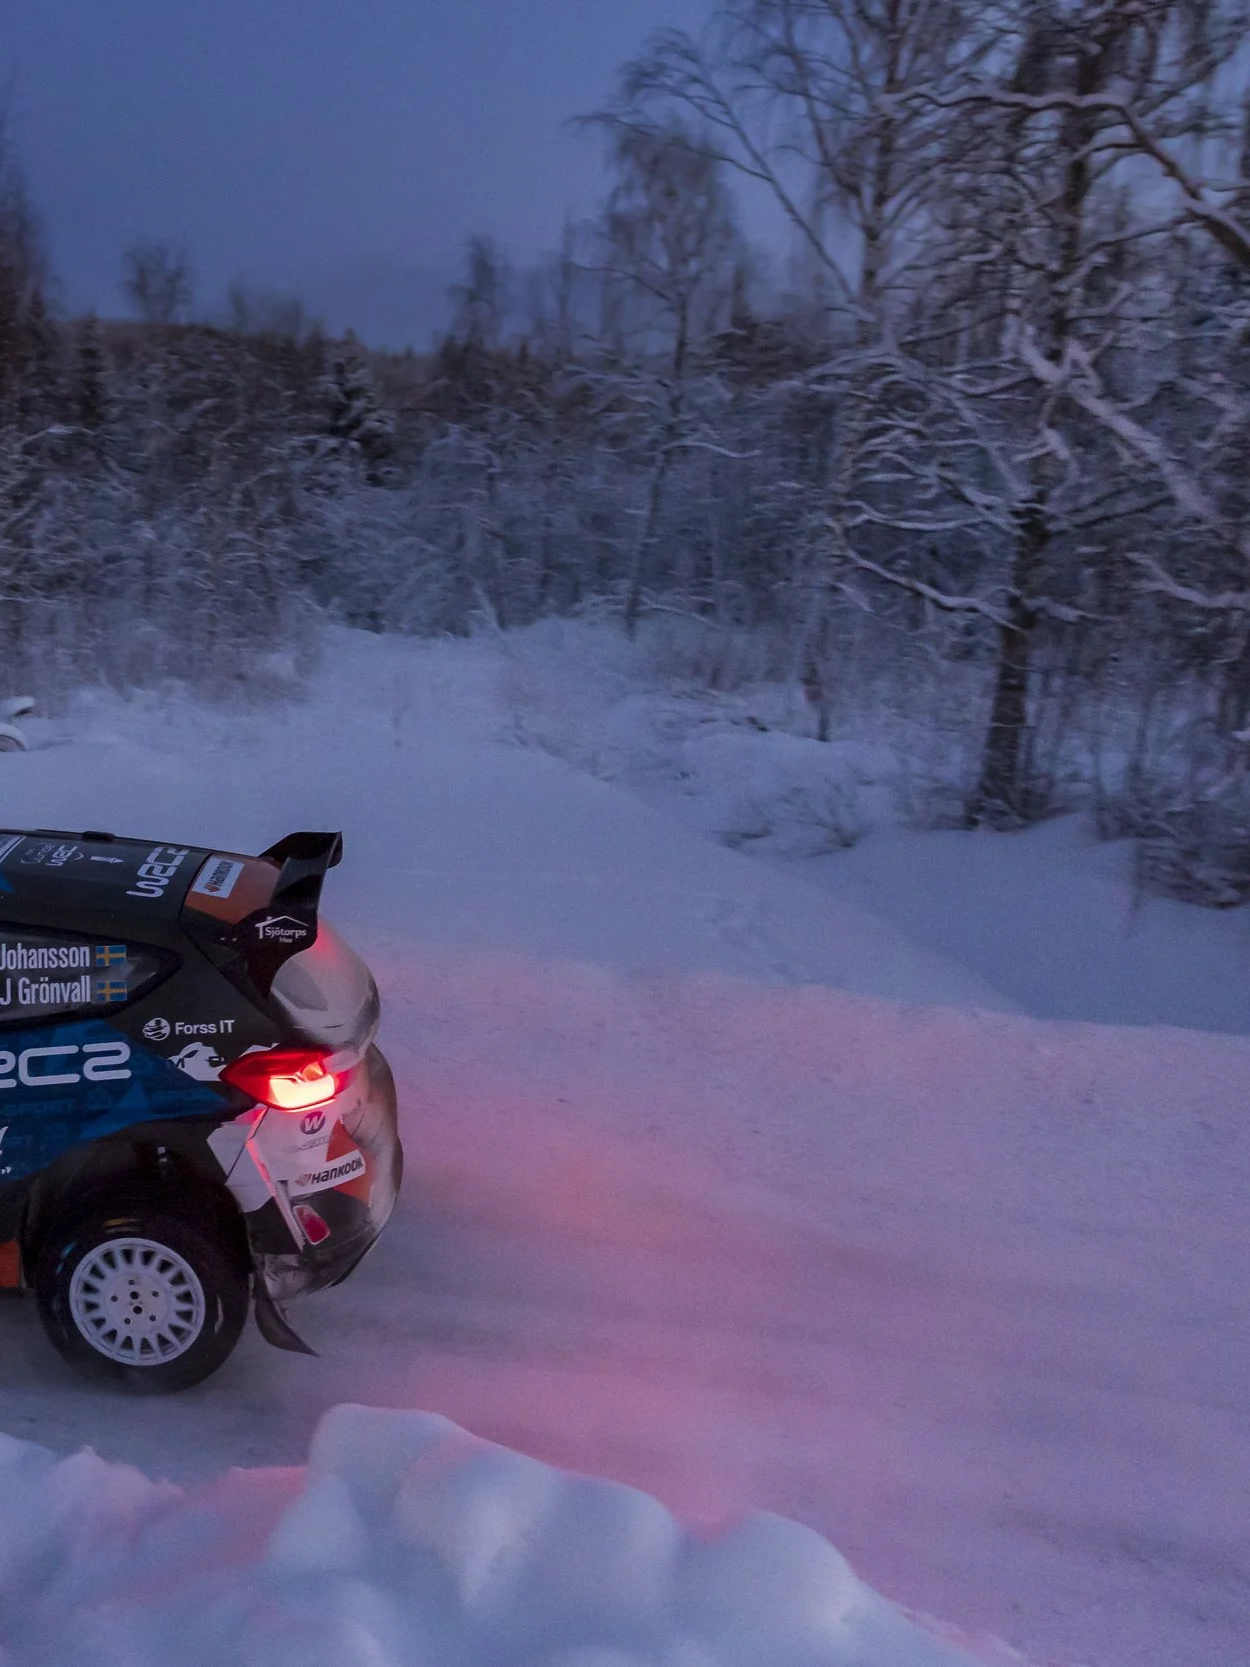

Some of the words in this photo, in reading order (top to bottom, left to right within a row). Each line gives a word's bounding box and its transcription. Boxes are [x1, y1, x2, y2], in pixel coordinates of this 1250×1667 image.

[0, 977, 12, 1006] J
[18, 975, 91, 1006] Grönvall
[174, 1021, 217, 1035] Forss
[219, 1019, 235, 1034] IT
